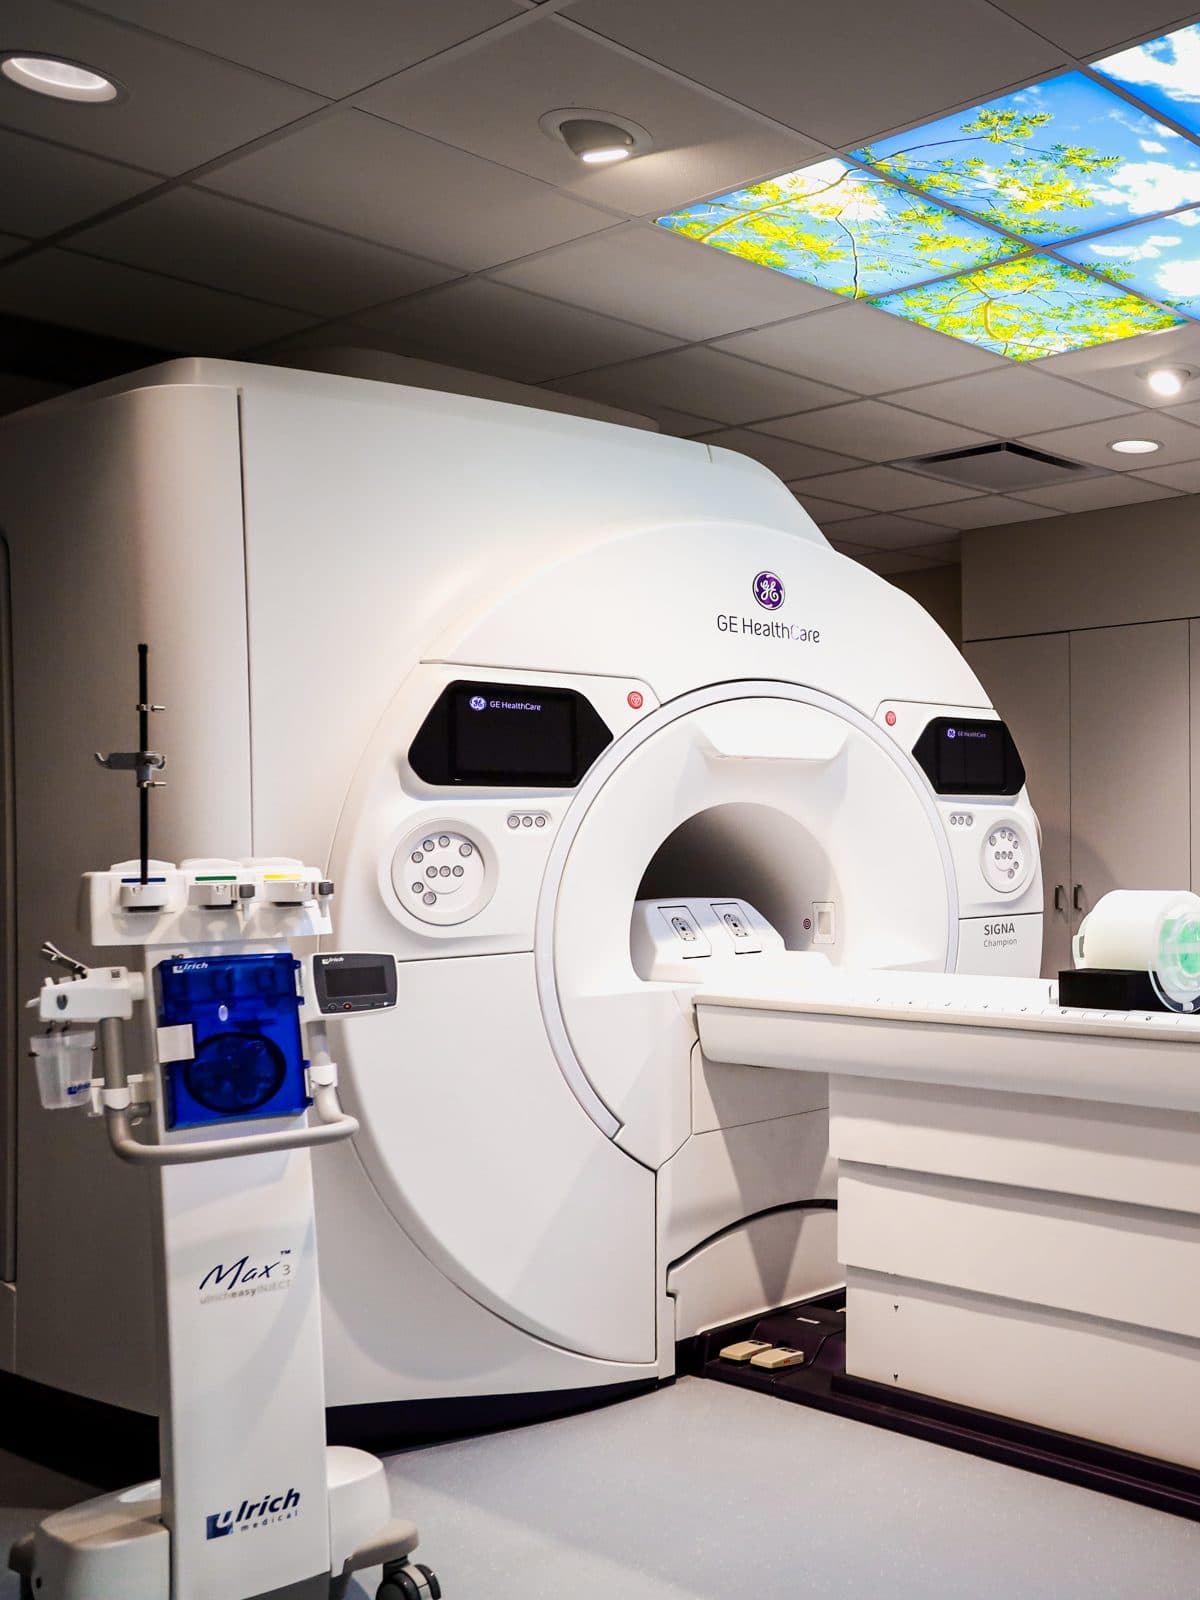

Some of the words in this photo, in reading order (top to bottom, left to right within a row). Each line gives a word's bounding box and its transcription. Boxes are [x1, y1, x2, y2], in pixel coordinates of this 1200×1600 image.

[717, 614, 738, 633] GE
[742, 617, 820, 643] HealthCare
[502, 701, 541, 711] HealthCare
[984, 922, 1015, 936] SIGNA
[983, 938, 1017, 948] Champion
[282, 1264, 291, 1276] 3
[206, 1487, 301, 1540] ulrich
[240, 1509, 299, 1532] medical
